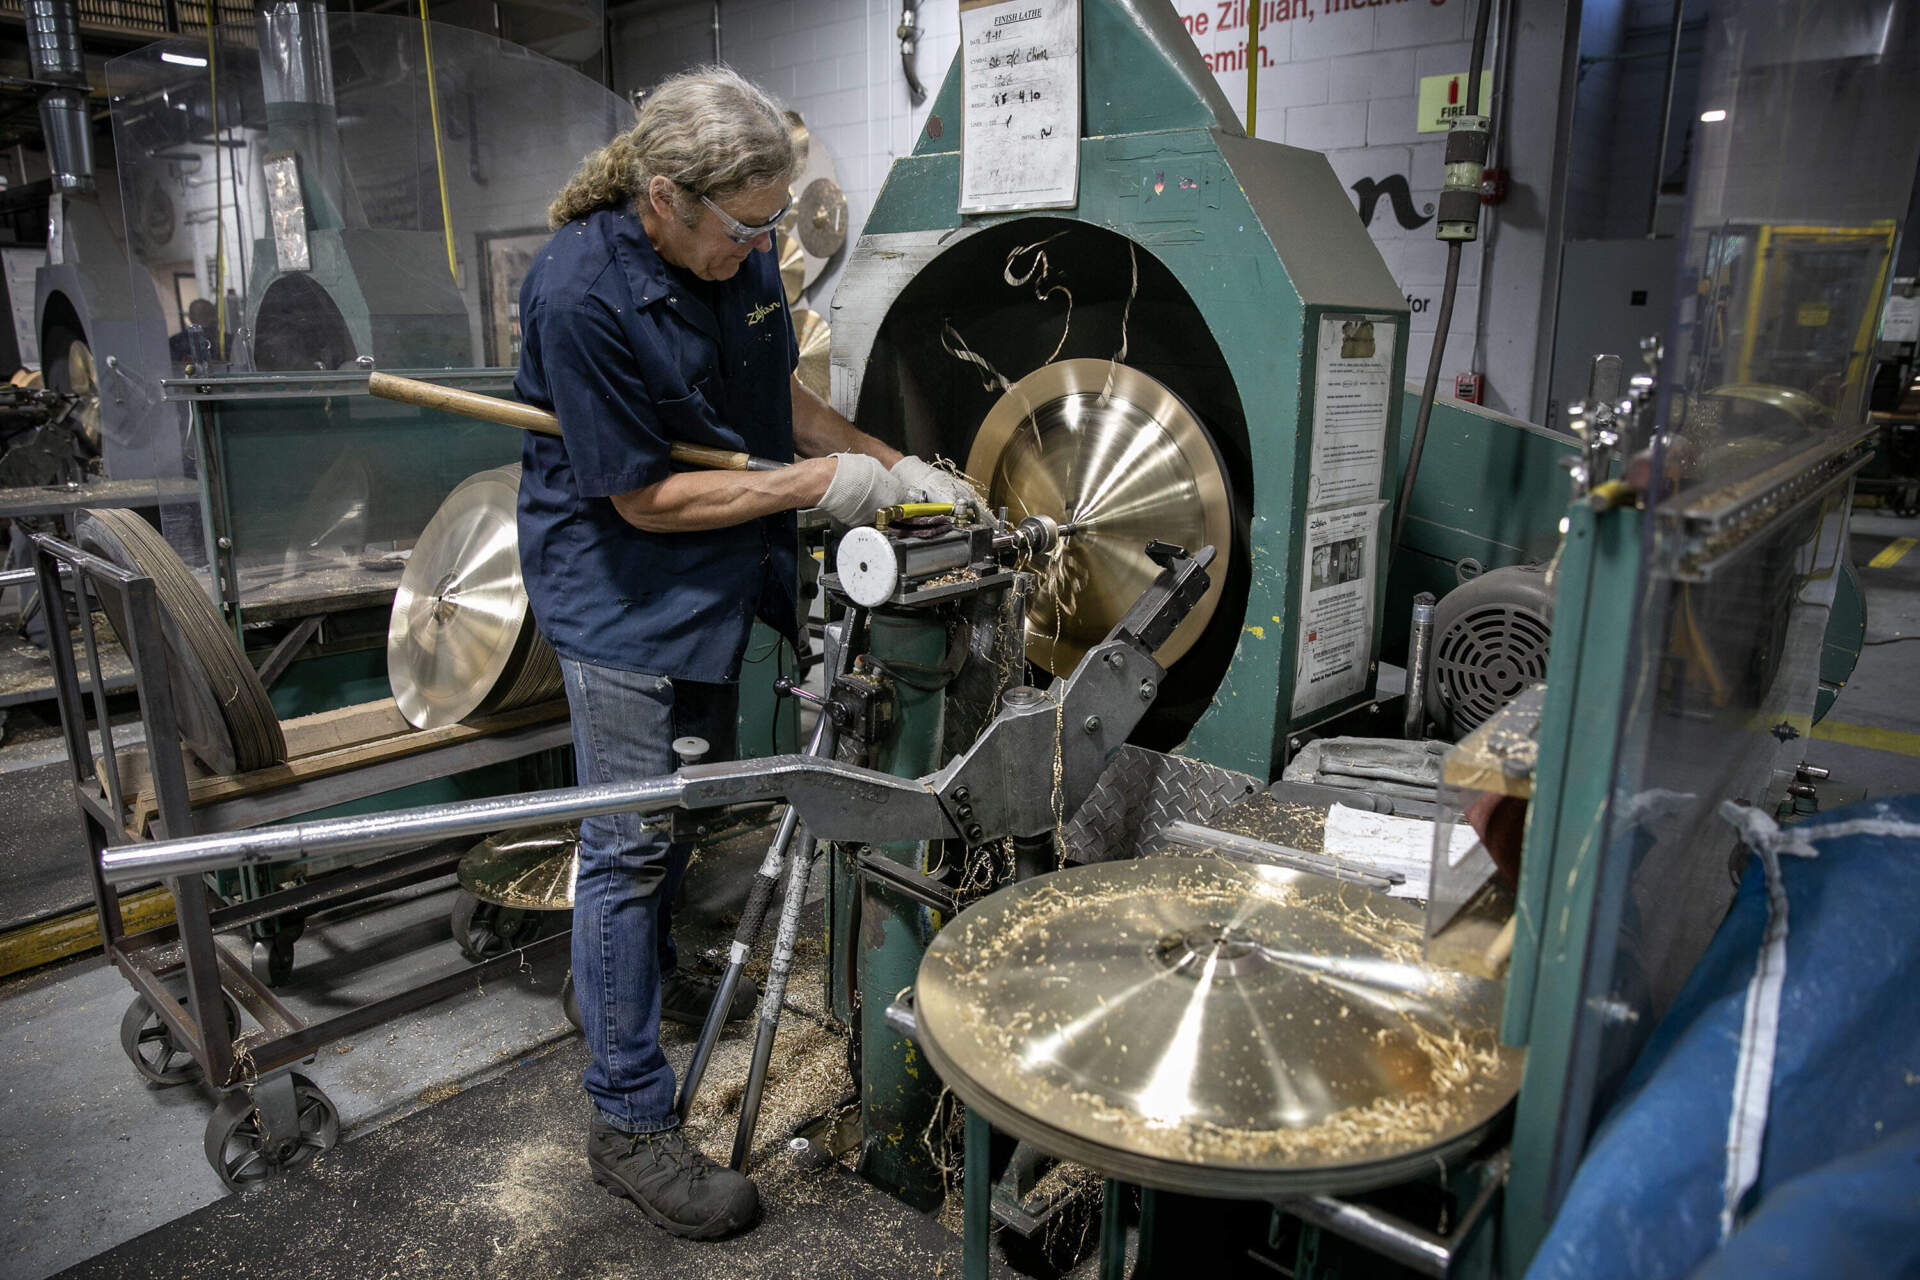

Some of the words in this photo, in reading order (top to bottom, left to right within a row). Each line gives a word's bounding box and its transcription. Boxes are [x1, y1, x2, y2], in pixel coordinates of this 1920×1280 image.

[994, 13, 1017, 25] FINISH
[1019, 8, 1042, 20] LATHE
[1441, 105, 1465, 118] FIRE
